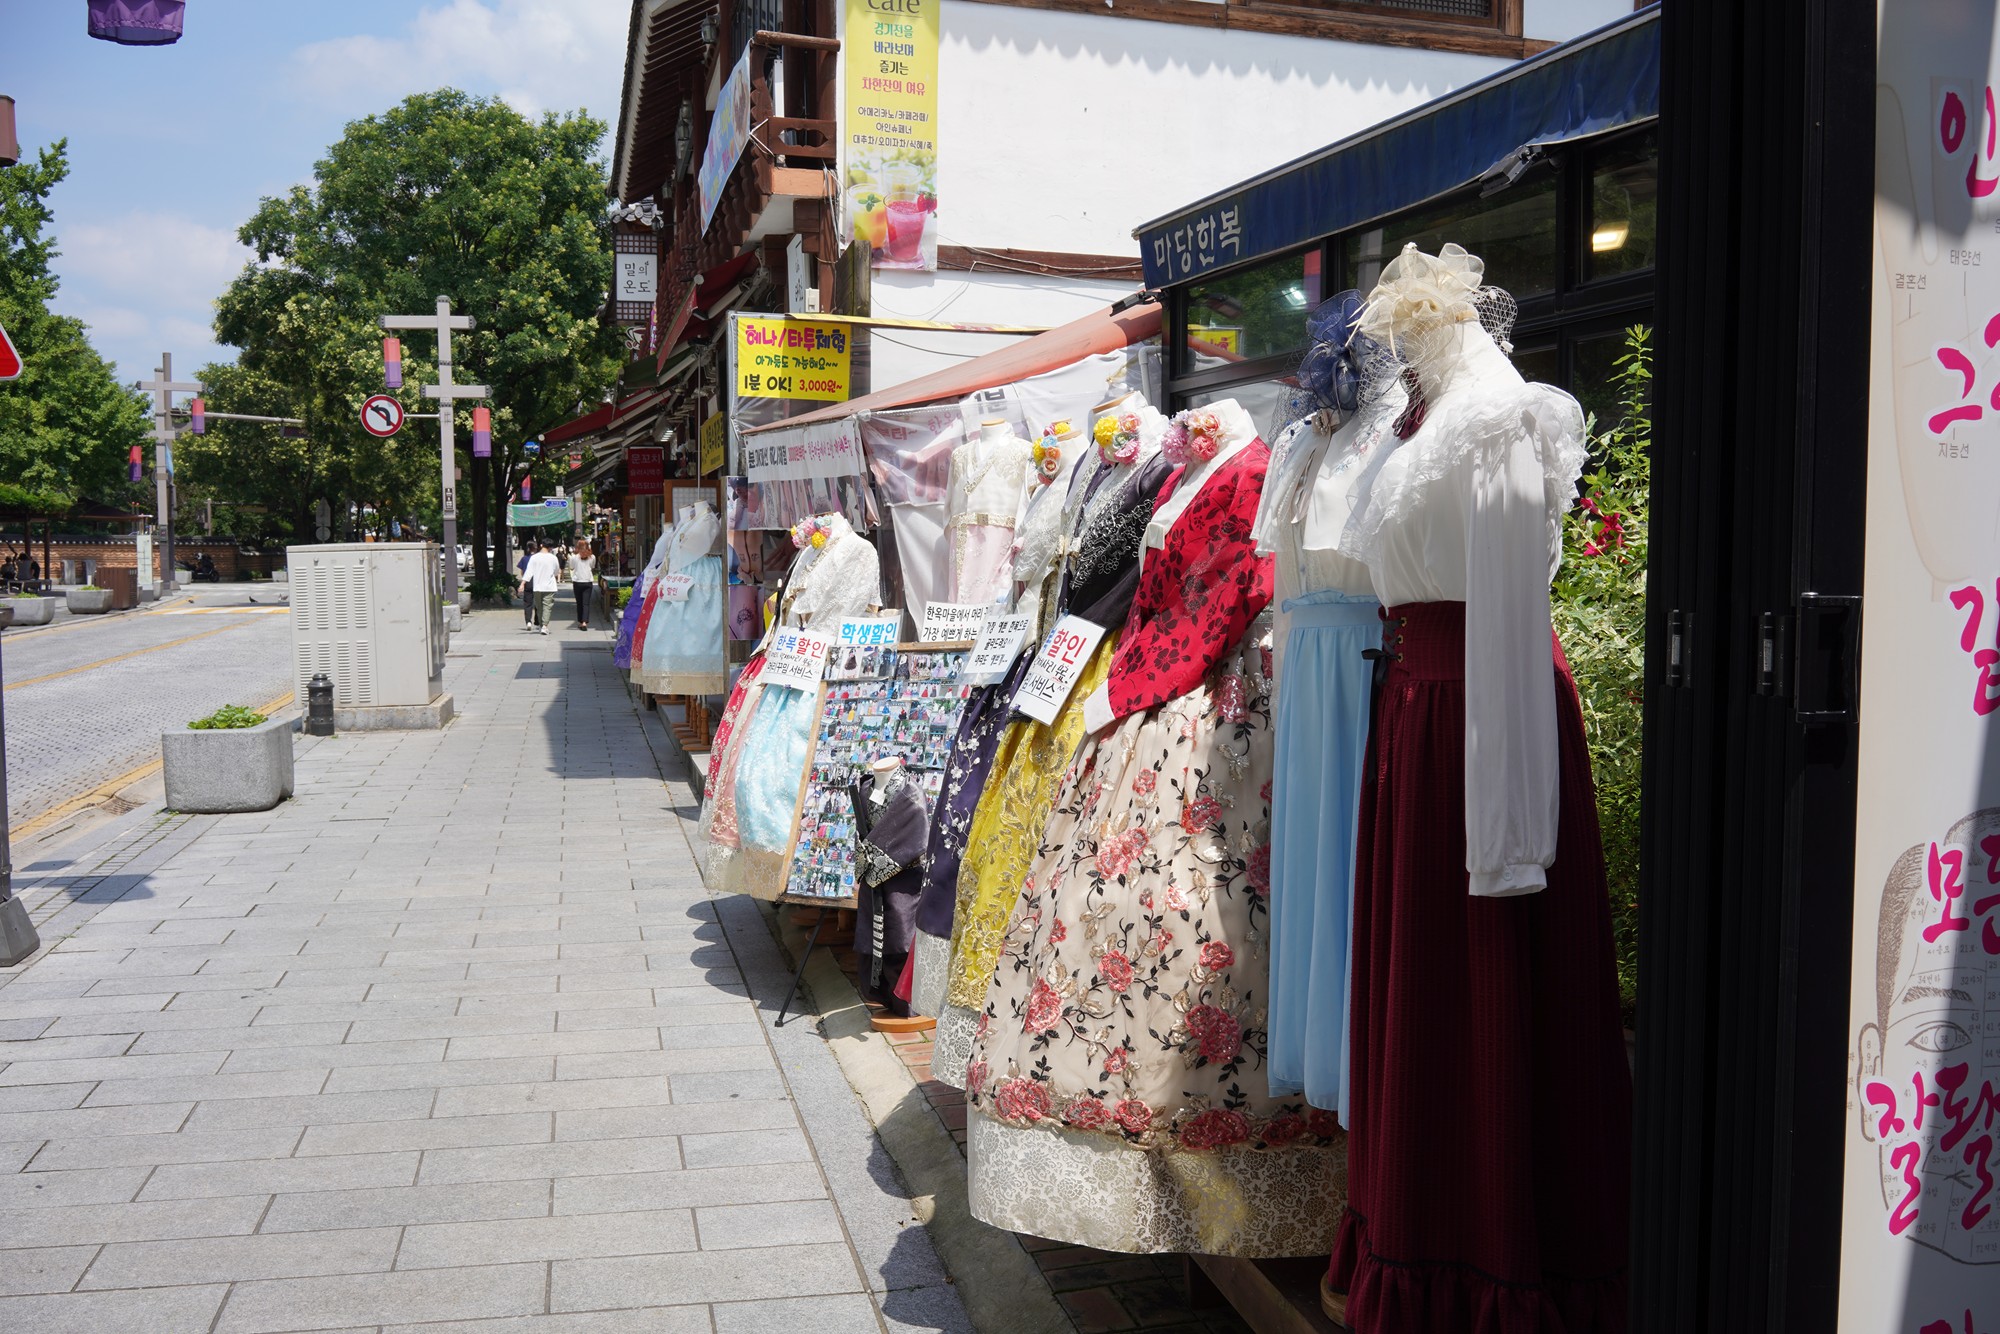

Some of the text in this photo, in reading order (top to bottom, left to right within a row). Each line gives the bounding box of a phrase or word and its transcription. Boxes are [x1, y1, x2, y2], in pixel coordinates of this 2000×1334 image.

[874, 22, 914, 38] 경기전을
[873, 41, 914, 57] 바라보며
[880, 59, 909, 76] 즐기는
[862, 76, 926, 97] 차한잔의 여유
[875, 122, 912, 134] 아인슈페너
[1154, 204, 1241, 281] 마당한복
[1950, 249, 1981, 266] 태양선
[624, 261, 650, 277] 밀의
[1895, 273, 1927, 291] 결혼선
[745, 324, 846, 354] 헤나/타투체험
[755, 354, 789, 369] 아가들도
[744, 374, 760, 391] 1분
[766, 376, 792, 392] OK!
[1938, 443, 1969, 459] 지능선
[926, 606, 971, 622] 한옥마을에서
[841, 622, 897, 645] 학생할인
[923, 626, 940, 641] 가장
[964, 627, 978, 641] 하는
